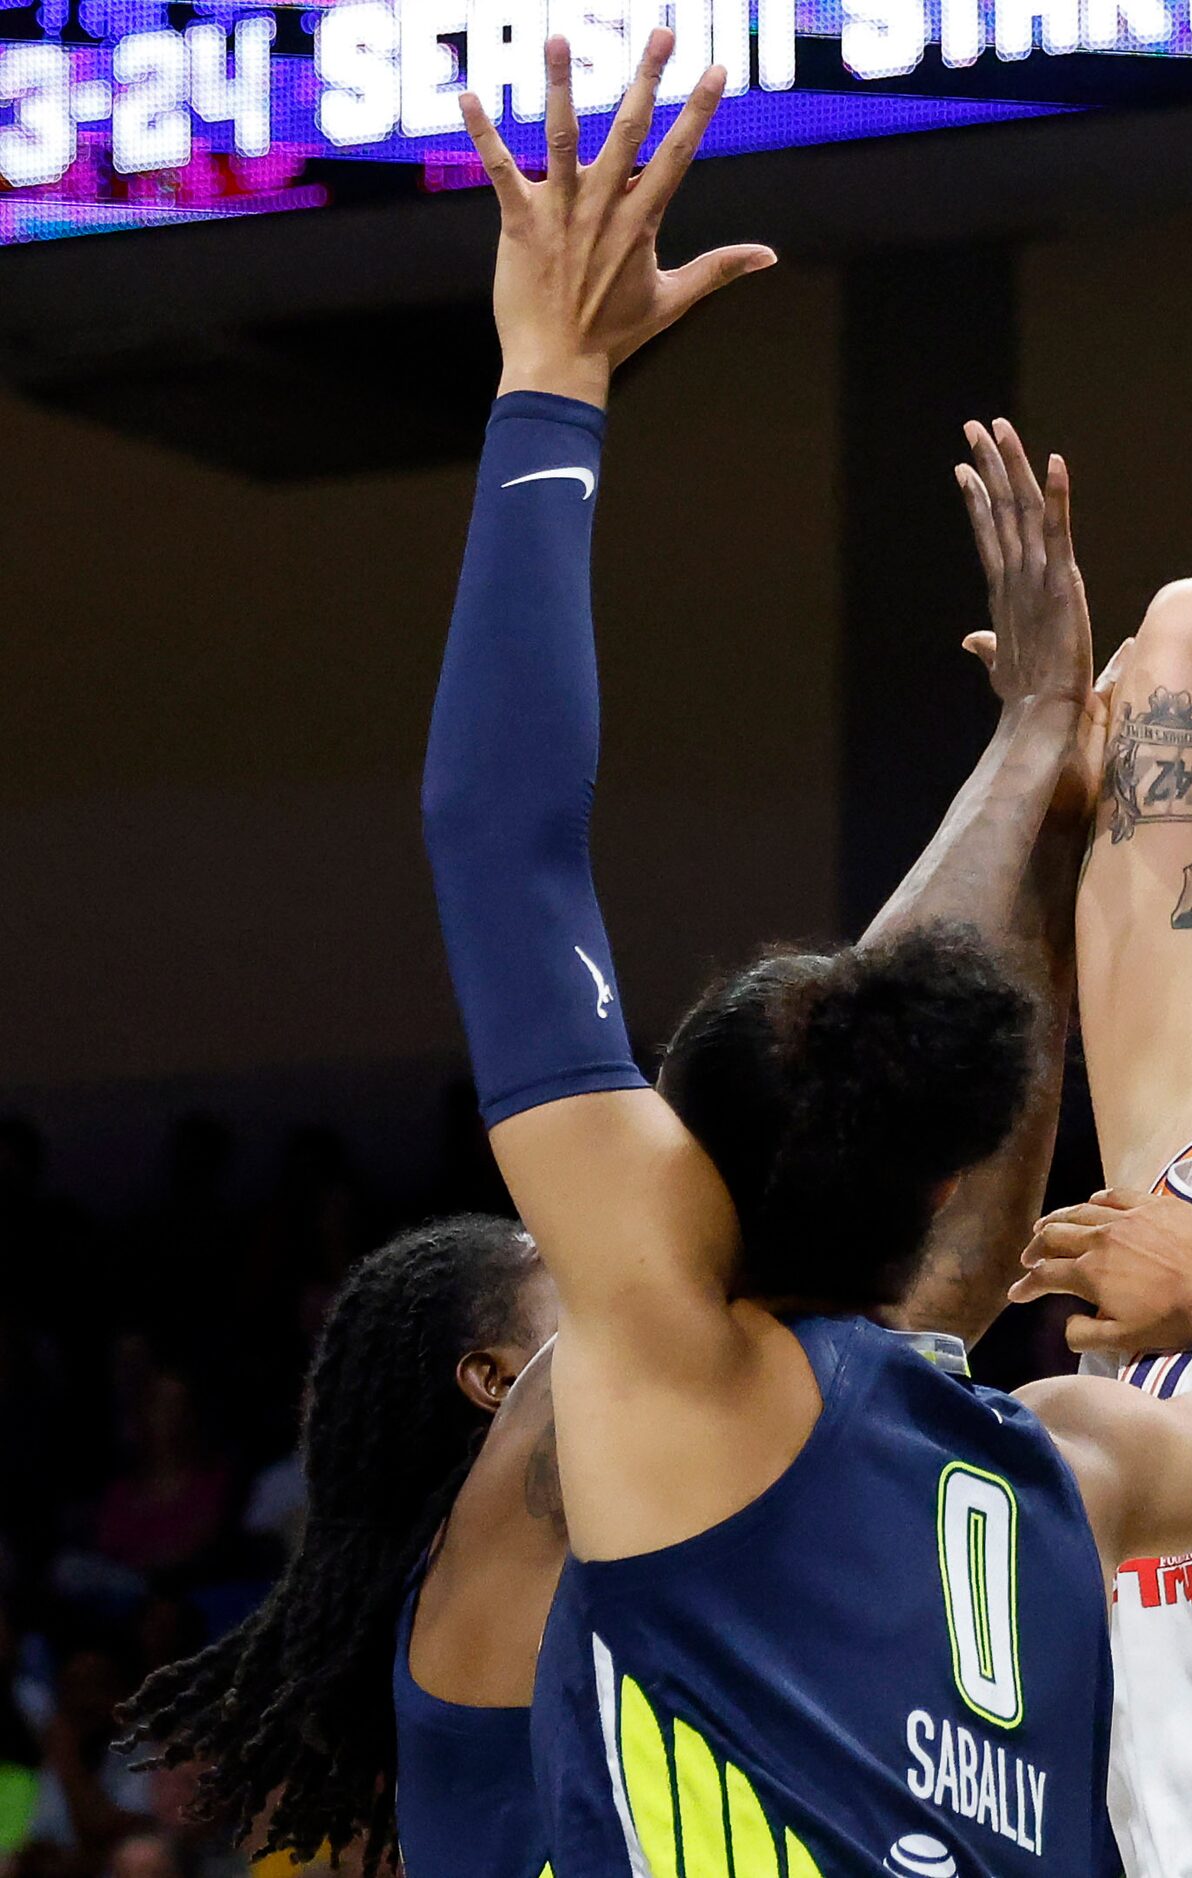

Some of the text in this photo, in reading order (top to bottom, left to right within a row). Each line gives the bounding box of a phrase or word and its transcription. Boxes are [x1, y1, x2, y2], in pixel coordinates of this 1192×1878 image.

[314, 0, 796, 147] SEASON
[938, 1460, 1024, 1730] 0
[907, 1709, 1046, 1857] SABALLY
